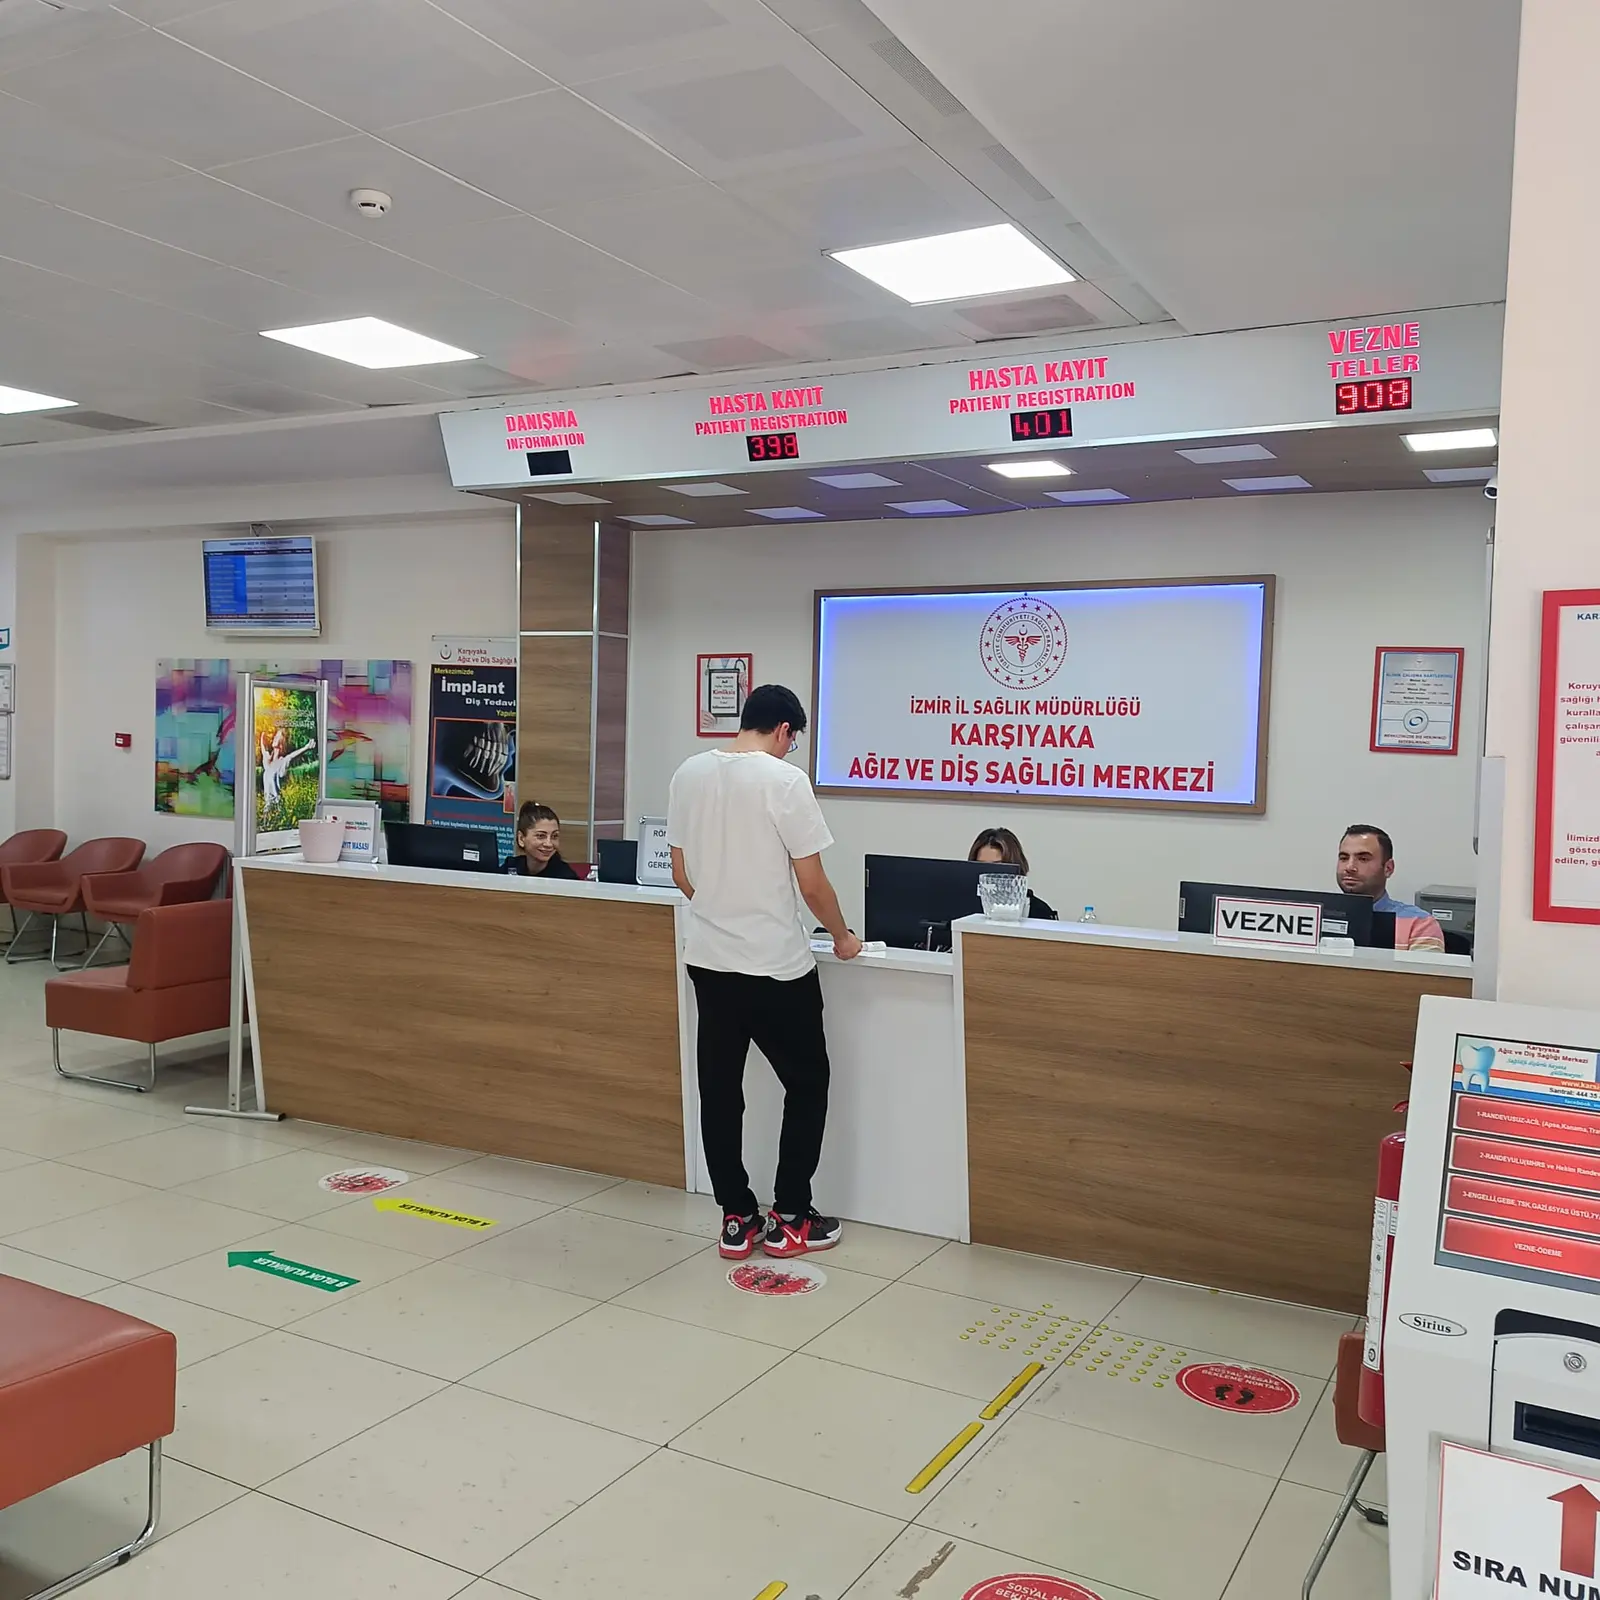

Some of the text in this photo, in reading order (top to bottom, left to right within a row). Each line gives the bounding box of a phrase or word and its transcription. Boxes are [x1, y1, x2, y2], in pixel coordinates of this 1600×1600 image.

[1328, 322, 1420, 356] VEZNE
[969, 356, 1108, 391] HASTA KAYIT
[1327, 354, 1420, 379] TELLER
[709, 385, 824, 415] HASTA KAYIT
[949, 382, 1136, 414] PATIENT REGISTRATION
[1338, 380, 1409, 413] 908
[505, 410, 578, 433] DANIŞMA
[695, 409, 848, 436] PATIENT REGISTRATION
[1014, 409, 1071, 437] 401
[506, 432, 585, 451] INFORMATION
[751, 434, 797, 459] 398
[1577, 613, 1600, 621] KAR
[441, 676, 505, 696] İmplant
[1568, 682, 1600, 691] Koruy
[465, 697, 480, 707] Diş
[910, 694, 1141, 717] İZMİR İL SAĞLIK MÜDÜRLÜĞÜ
[1560, 696, 1594, 704] sağlığı
[951, 723, 1095, 750] KARŞIYAKA
[848, 752, 1214, 792] AĞIZ VE DİŞ SAĞLIĞI MERKEZİ
[647, 861, 673, 869] GEREK
[1221, 909, 1314, 936] VEZNE
[1413, 1316, 1451, 1334] Sirius
[1453, 1550, 1527, 1588] SIRA
[1006, 1582, 1048, 1600] SOSYAL
